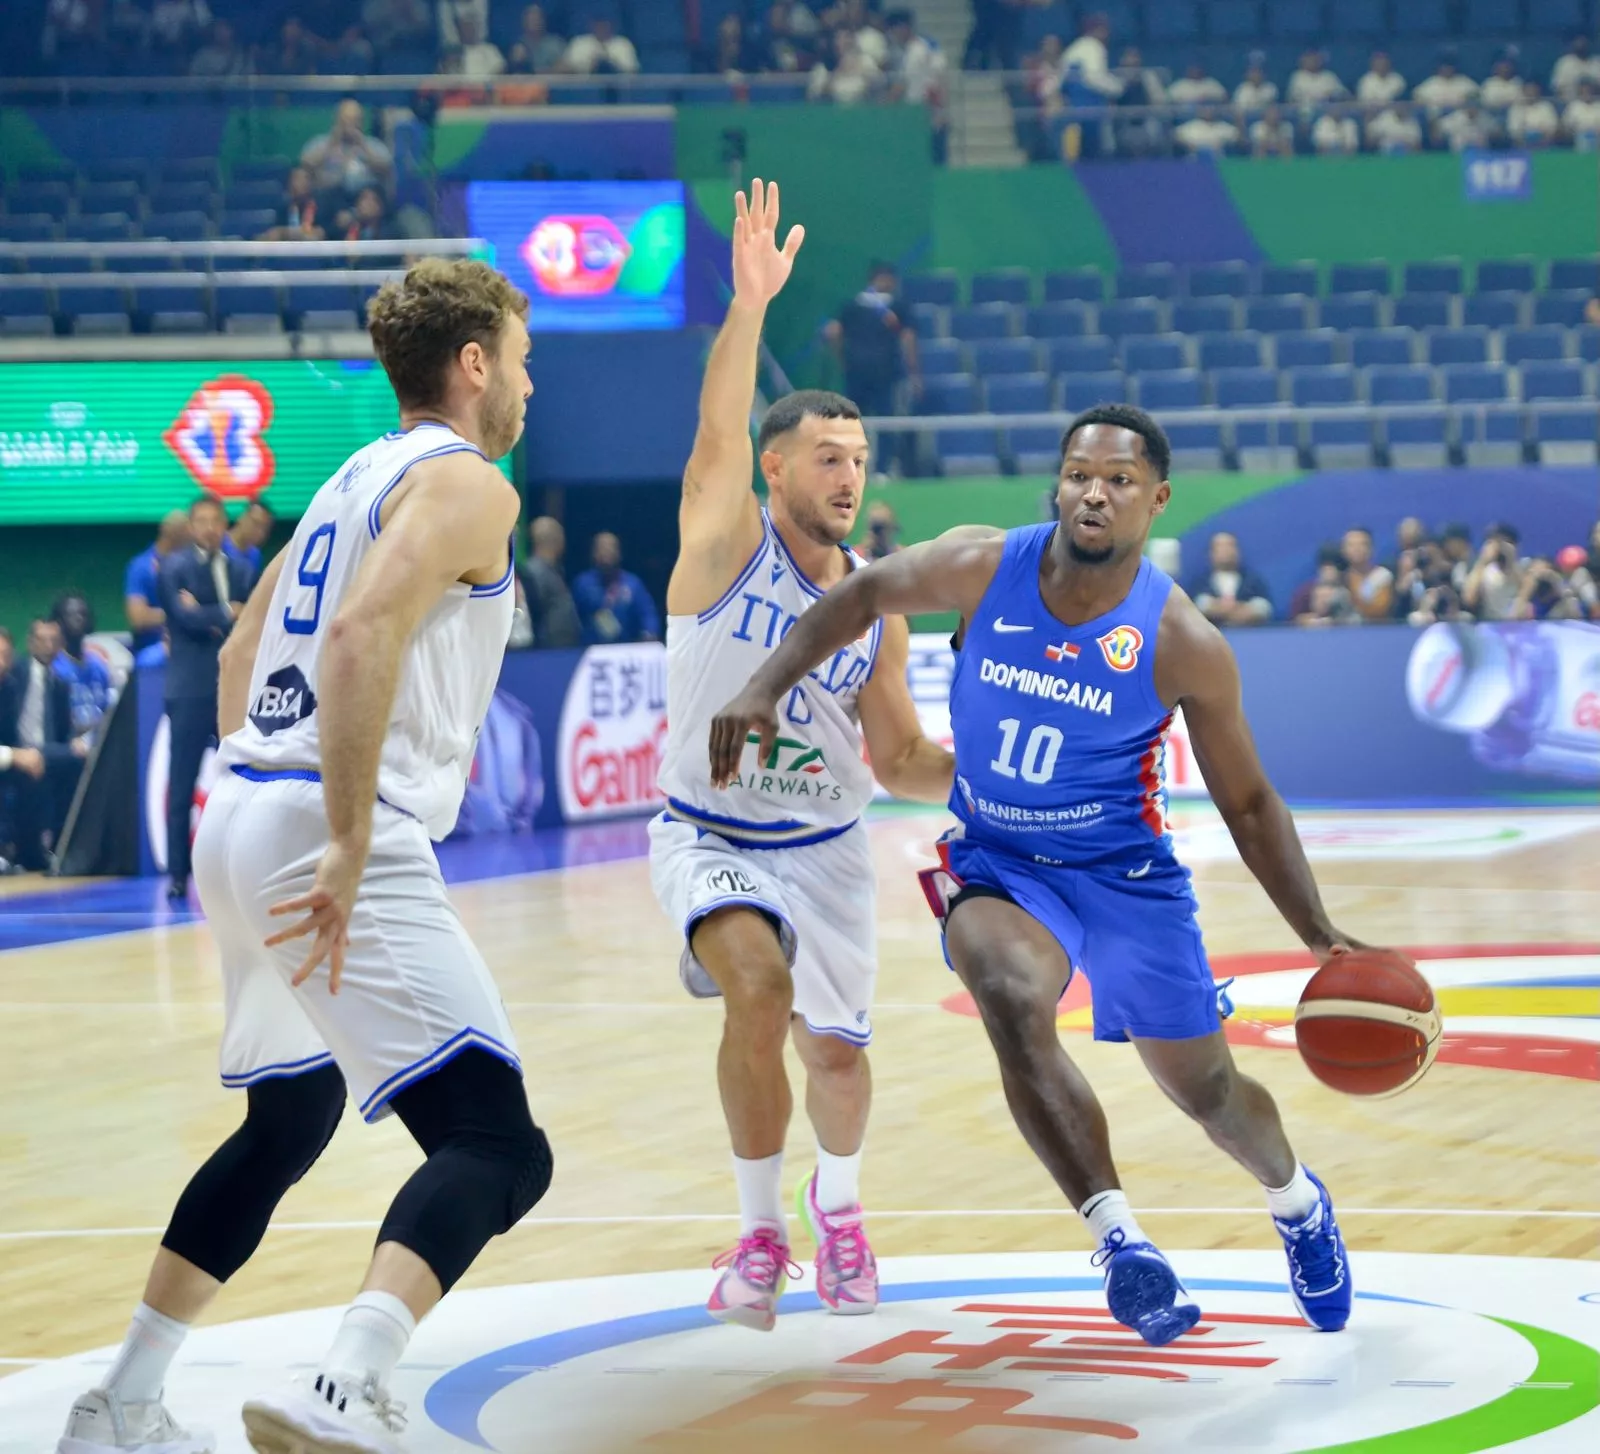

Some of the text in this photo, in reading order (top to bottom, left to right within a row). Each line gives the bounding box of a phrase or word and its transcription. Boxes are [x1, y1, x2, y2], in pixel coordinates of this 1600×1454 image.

[283, 520, 337, 635] 9
[979, 658, 1113, 716] DOMINICANA
[990, 718, 1064, 784] 10
[728, 773, 842, 801] AIRWAYS
[978, 798, 1103, 821] BANRESERVAS
[1008, 823, 1018, 832] de
[1018, 823, 1042, 832] todos
